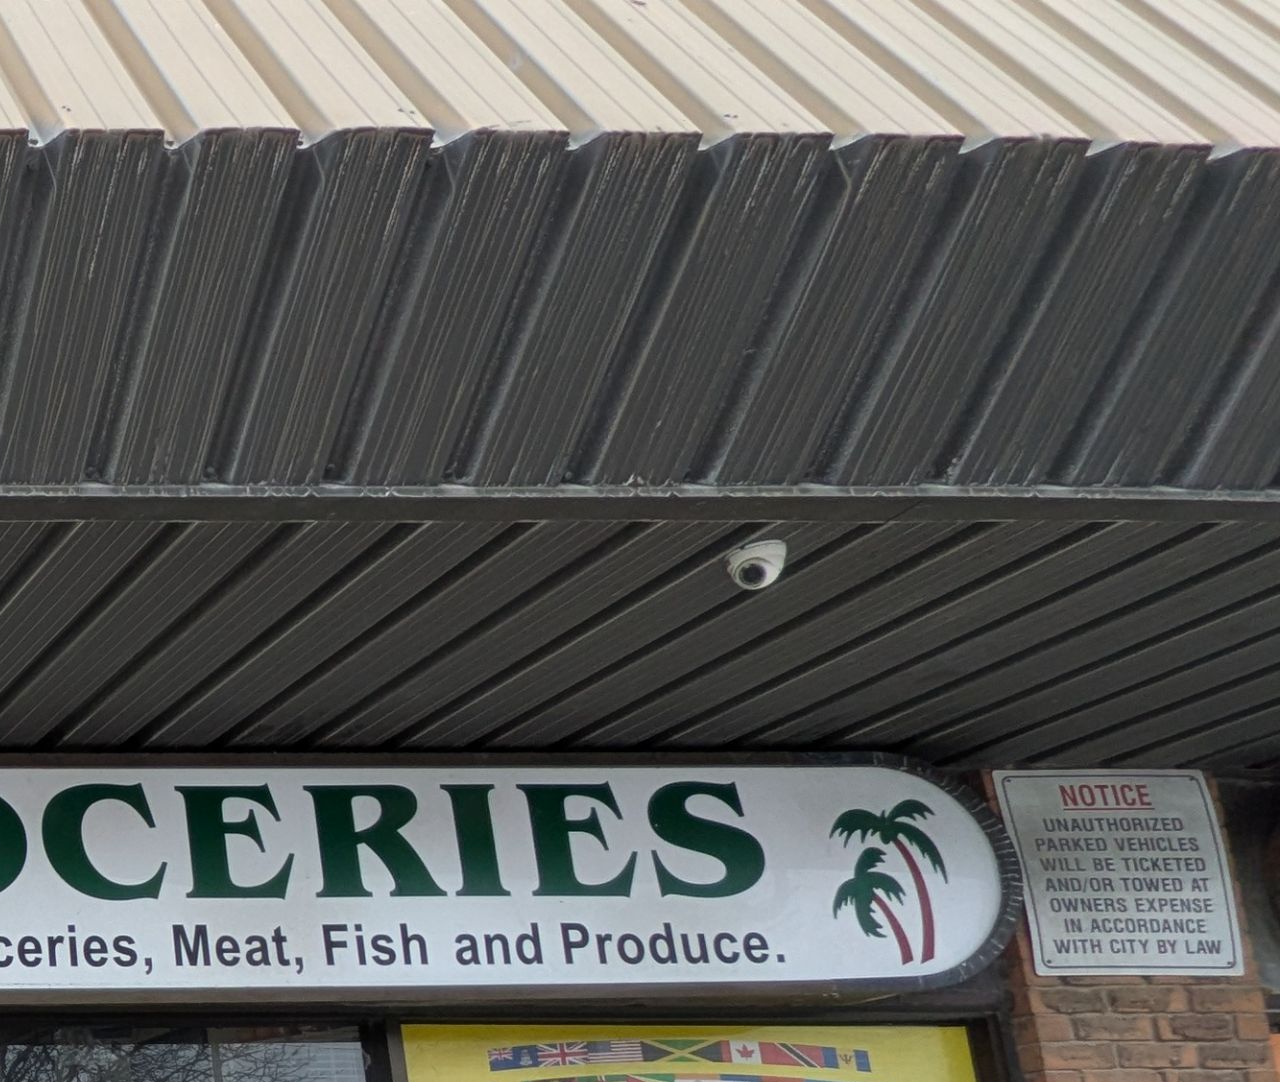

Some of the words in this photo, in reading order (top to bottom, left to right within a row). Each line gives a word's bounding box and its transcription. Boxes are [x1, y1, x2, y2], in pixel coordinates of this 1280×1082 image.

[1059, 784, 1153, 807] NOTICE
[1042, 817, 1184, 832] UNAUTHORIZED
[1035, 837, 1107, 852] PARKED
[1113, 837, 1200, 852] VEHICLES
[1040, 857, 1086, 872] WILL
[1093, 857, 1116, 872] BE
[1121, 857, 1207, 872] TICKETED
[1045, 878, 1114, 892] AND/OR
[1122, 878, 1183, 892] TOWED
[1191, 878, 1210, 892] AT
[1049, 898, 1128, 913] OWNERS
[1135, 898, 1214, 913] EXPENSE
[1064, 918, 1083, 933] IN
[1090, 918, 1208, 934] ACCORDANCE
[172, 924, 304, 973] Meat,
[322, 922, 429, 966] Fish
[455, 922, 544, 966] and
[560, 922, 787, 966] Produce.
[1053, 939, 1103, 954] WITH
[1109, 939, 1149, 954] CITY
[1157, 939, 1177, 954] BY
[1185, 939, 1222, 955] LAW
